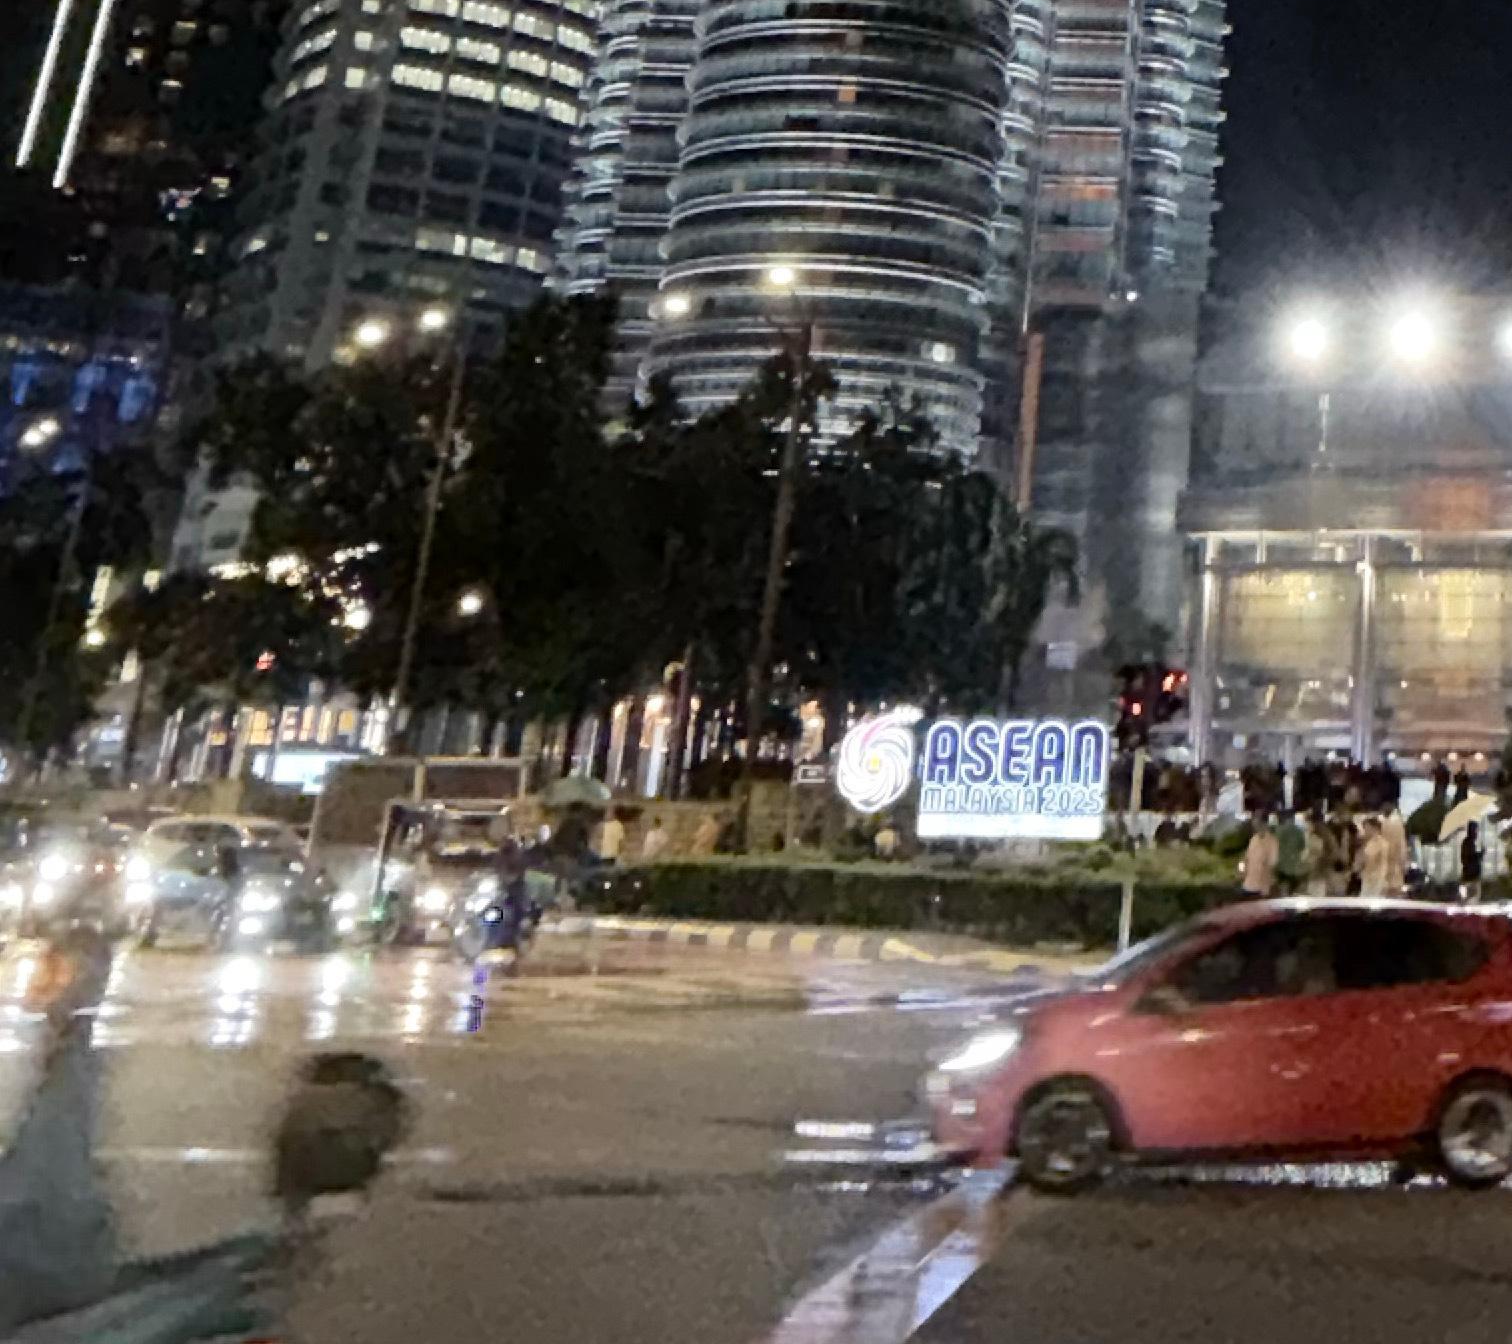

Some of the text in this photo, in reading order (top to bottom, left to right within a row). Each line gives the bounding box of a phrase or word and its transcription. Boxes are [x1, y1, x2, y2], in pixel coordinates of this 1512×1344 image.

[924, 722, 1105, 785] ASEAN
[923, 786, 1104, 813] MALAYSIA 2025
